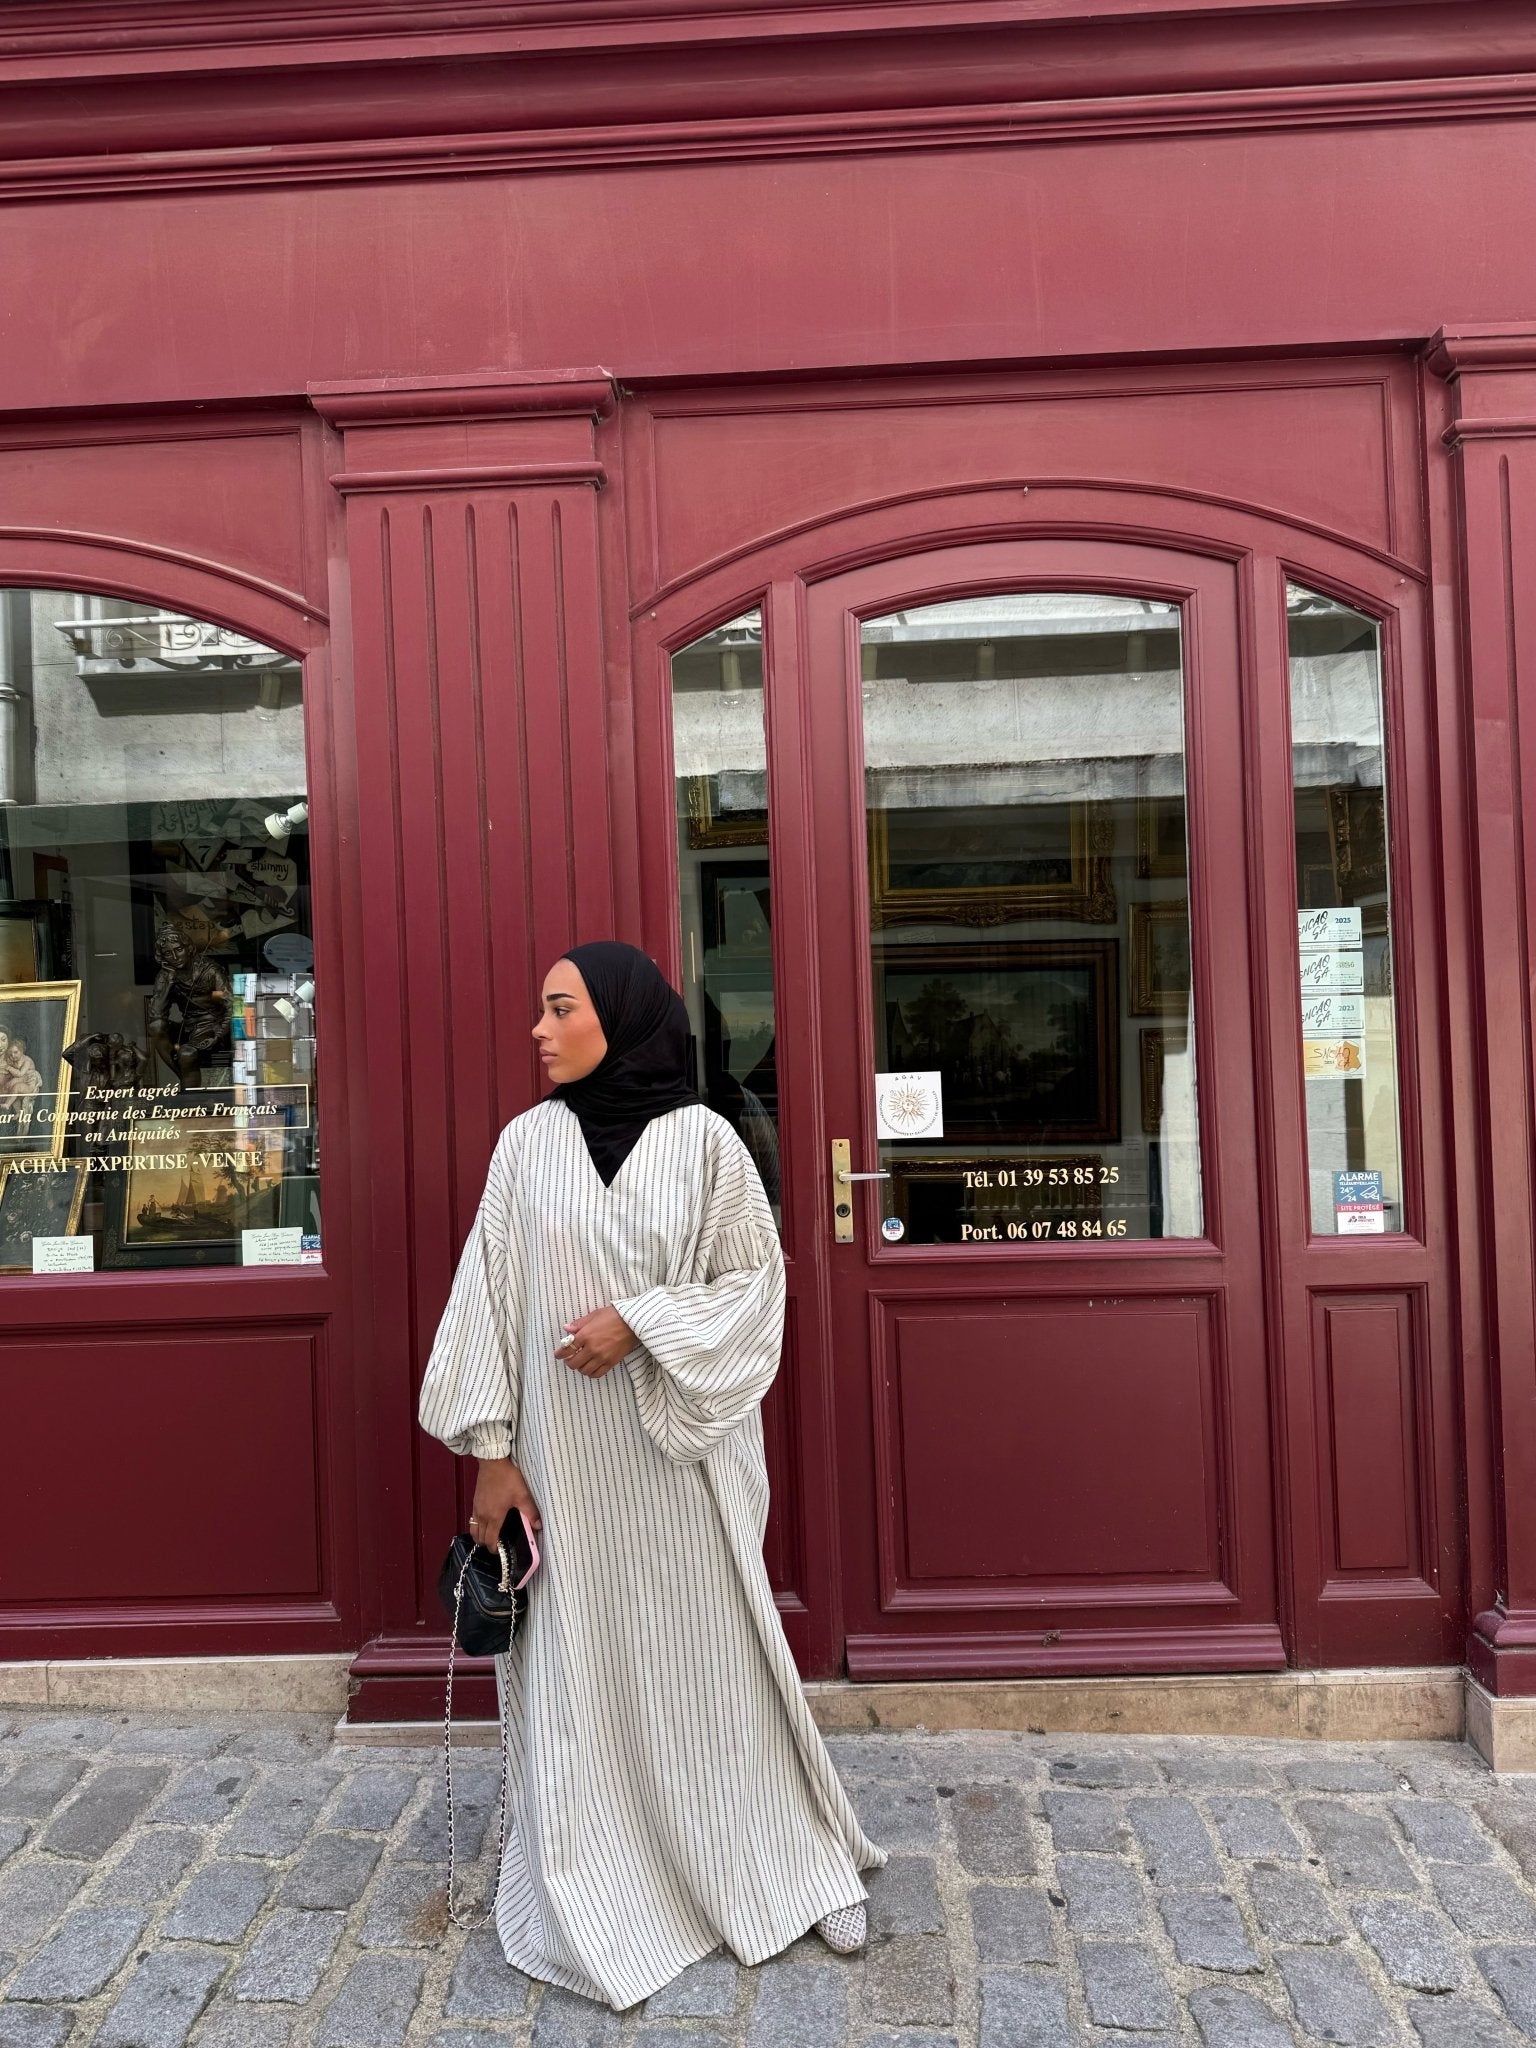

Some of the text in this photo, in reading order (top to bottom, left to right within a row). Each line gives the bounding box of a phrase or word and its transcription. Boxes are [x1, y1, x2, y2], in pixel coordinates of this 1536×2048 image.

[197, 845, 211, 864] 7
[250, 860, 289, 881] shimmy
[1338, 1004, 1355, 1012] 2023
[85, 1083, 179, 1102] Expert agréé
[0, 1113, 15, 1124] ar
[18, 1109, 32, 1123] la
[122, 1106, 147, 1120] des
[151, 1103, 207, 1121] Experts
[211, 1101, 278, 1119] Français
[85, 1126, 181, 1144] en Antiquités
[8, 1158, 70, 1175] ACHAT
[86, 1154, 188, 1172] EXPERTISE
[962, 1170, 994, 1188] Tél.
[998, 1169, 1018, 1187] 01
[1023, 1168, 1044, 1187] 39
[1048, 1168, 1069, 1186] 53
[1073, 1167, 1094, 1185] 85
[1099, 1166, 1120, 1184] 25
[1339, 1173, 1379, 1181] ALARME
[960, 1219, 1127, 1241] Port. 06 07 48 84 65
